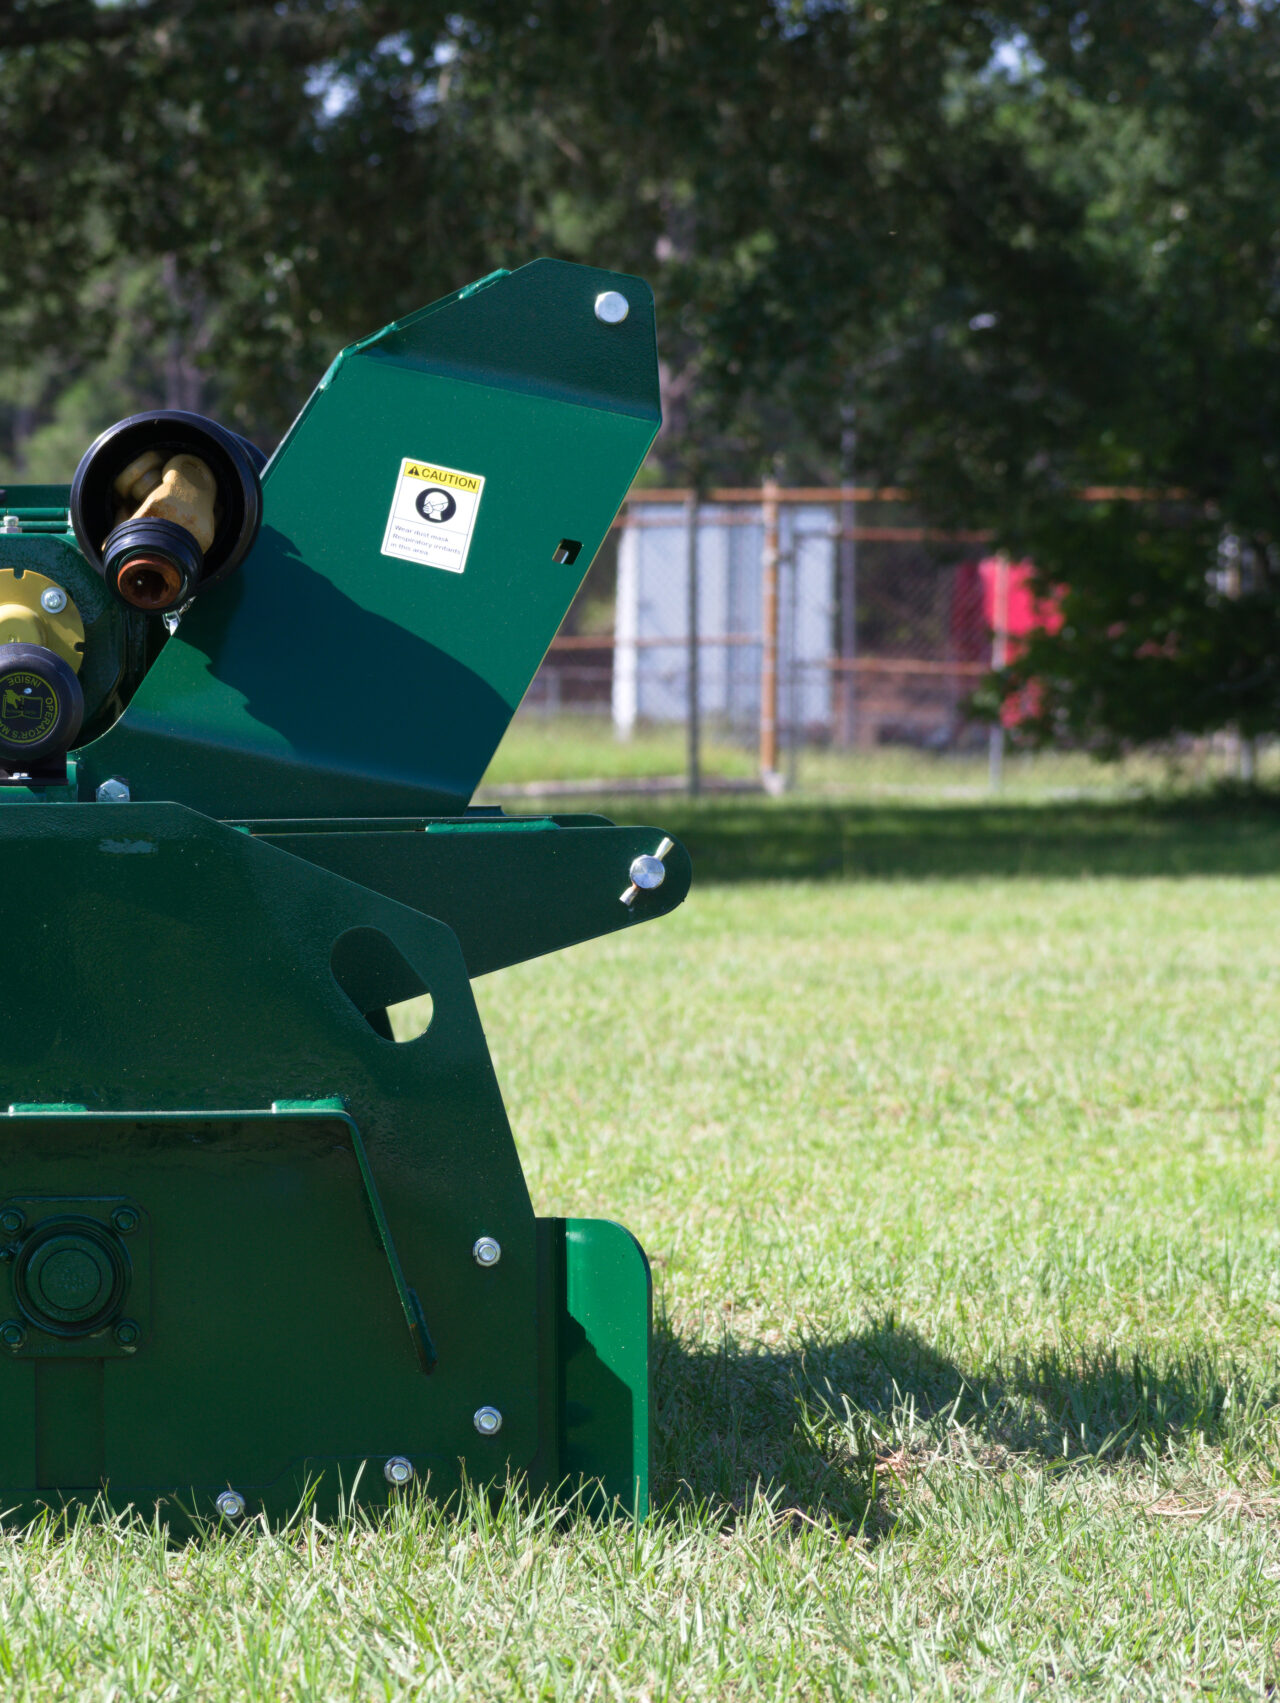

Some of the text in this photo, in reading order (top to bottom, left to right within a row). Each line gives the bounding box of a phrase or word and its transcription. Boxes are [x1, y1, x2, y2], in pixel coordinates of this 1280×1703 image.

[422, 468, 477, 489] CAUTION
[395, 525, 412, 533] Wear
[393, 533, 432, 548] Respiratory
[8, 675, 42, 688] INSIDE
[11, 697, 53, 739] OPERATOR'S
